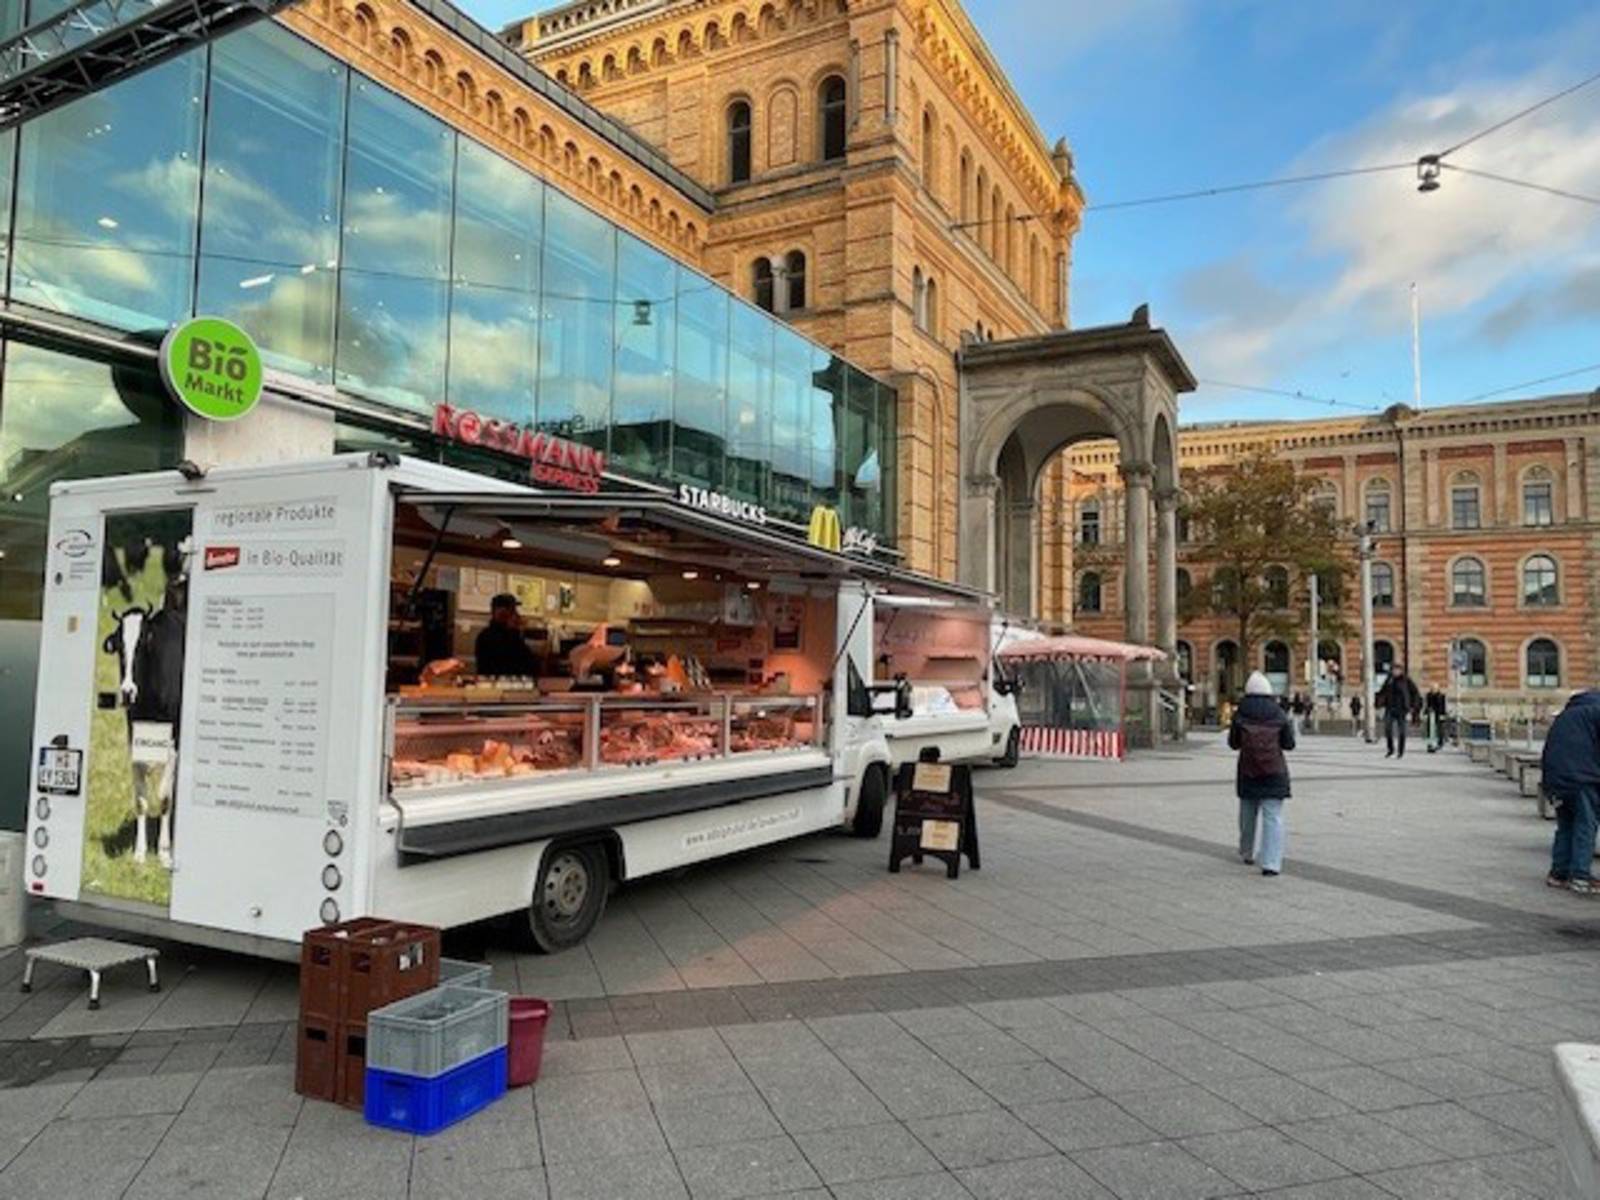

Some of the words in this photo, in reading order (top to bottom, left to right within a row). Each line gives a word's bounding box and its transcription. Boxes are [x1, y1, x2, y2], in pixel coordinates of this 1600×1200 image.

[190, 337, 248, 381] Bio
[184, 372, 244, 405] Markt
[432, 403, 606, 474] ROSSMANN
[215, 508, 273, 527] regionale
[277, 504, 336, 521] Produkte
[679, 484, 767, 524] STARBUCKS
[262, 549, 344, 567] Bio-Qualität
